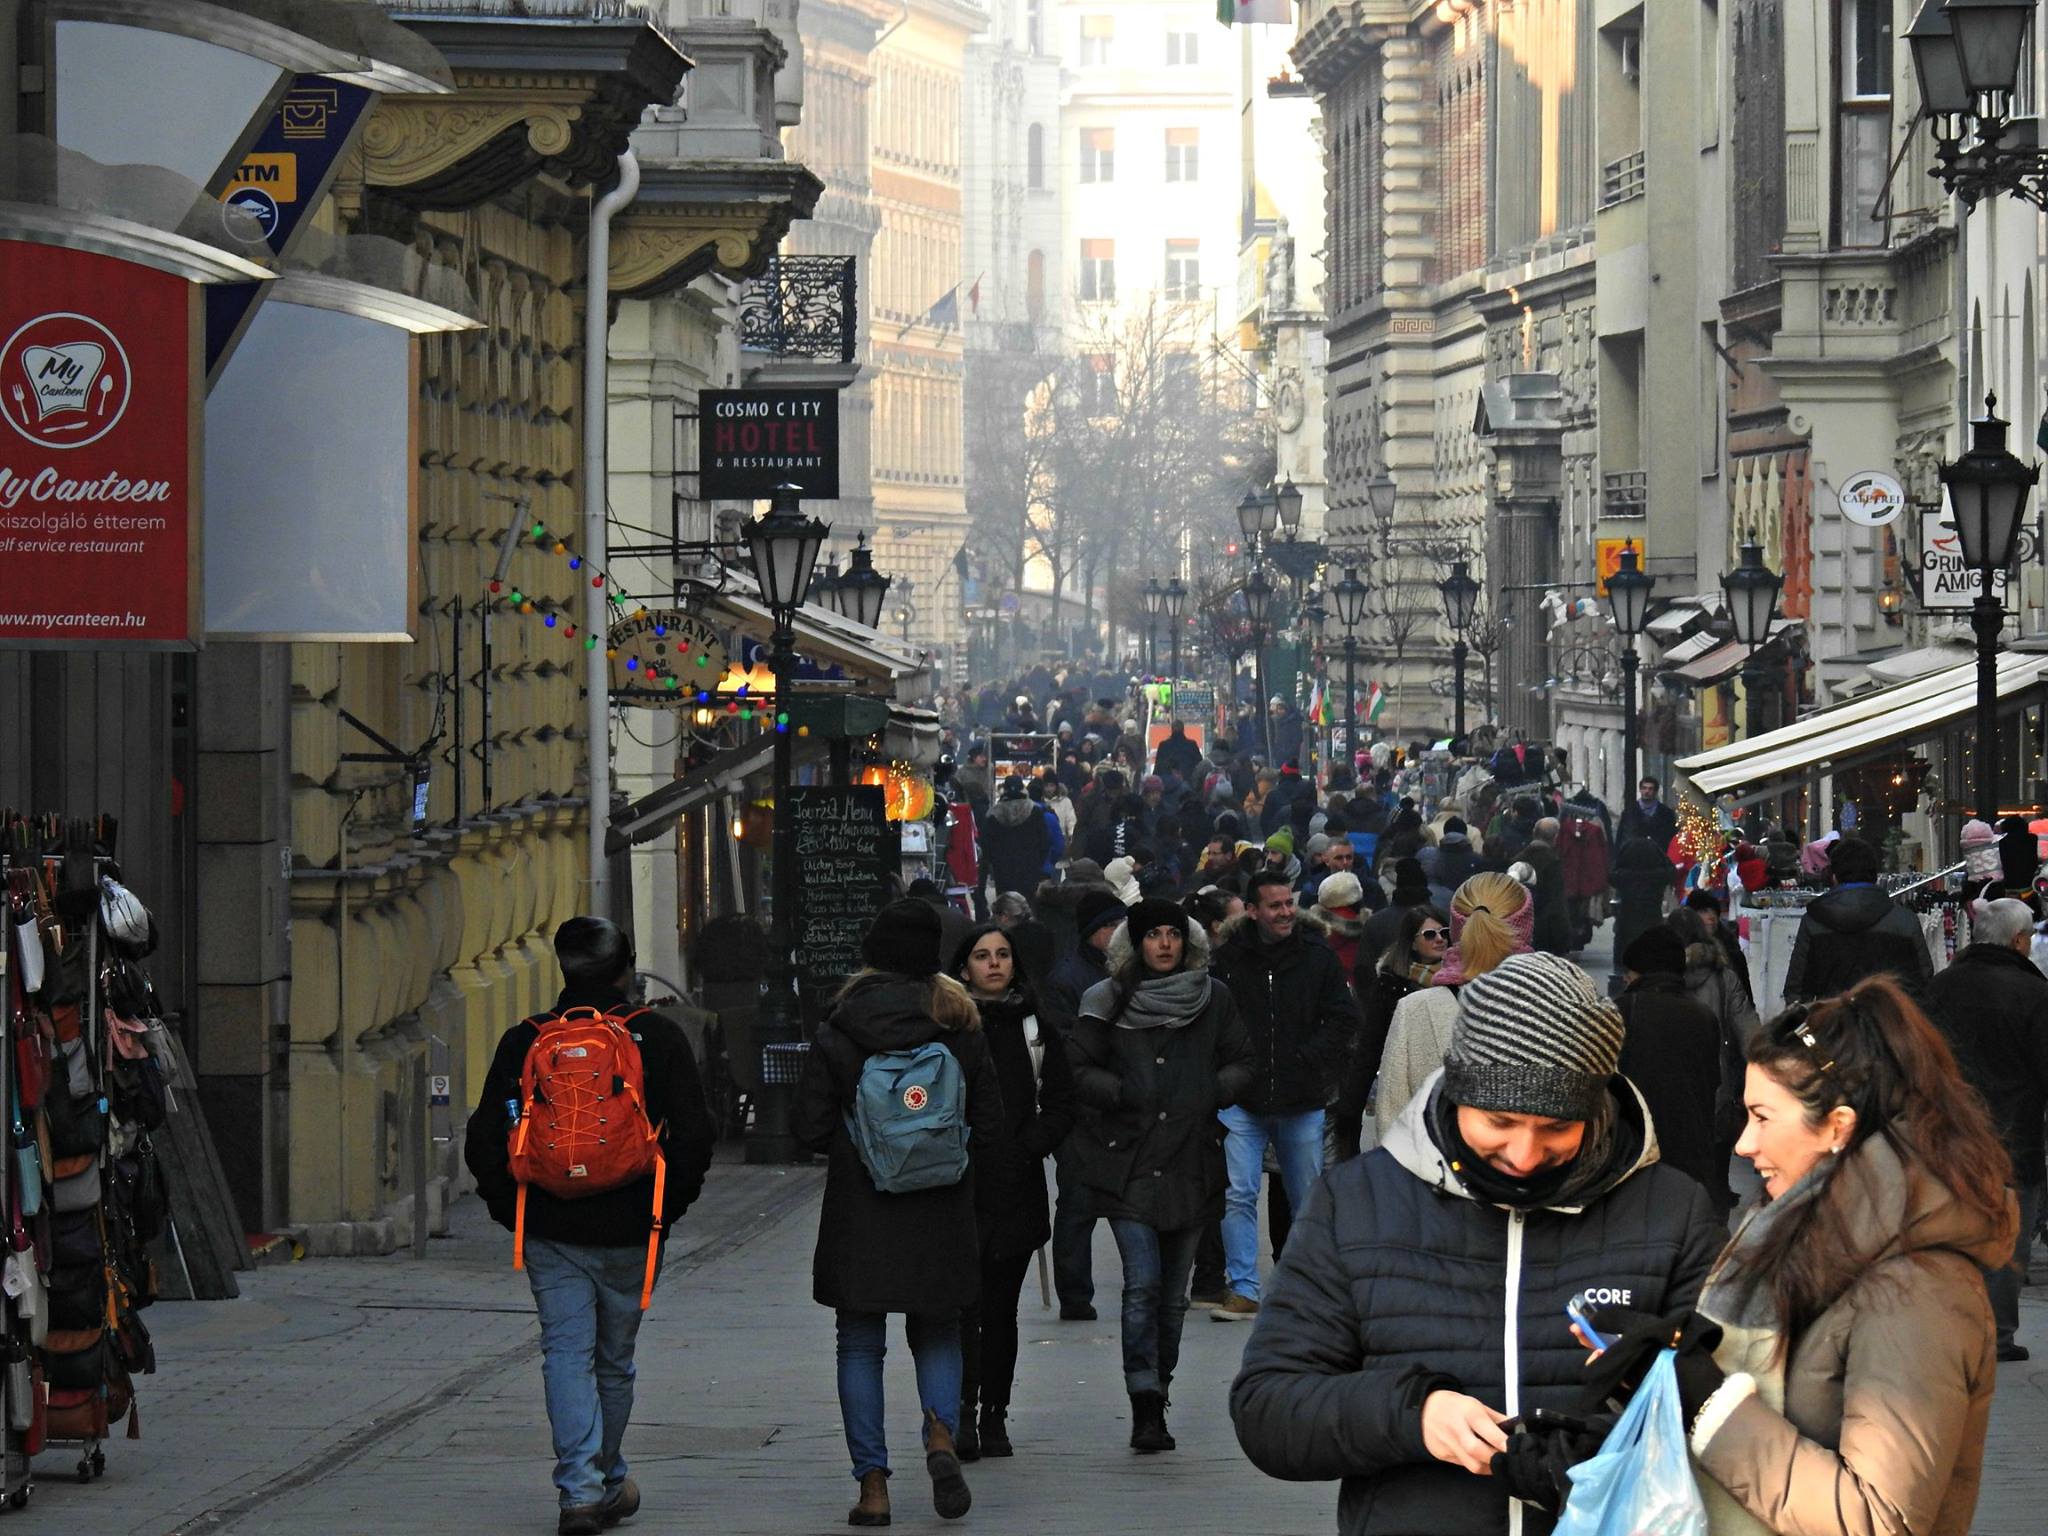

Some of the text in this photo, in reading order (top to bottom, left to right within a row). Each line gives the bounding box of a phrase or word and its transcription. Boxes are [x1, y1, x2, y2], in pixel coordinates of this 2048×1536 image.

[38, 356, 84, 385] My
[40, 383, 83, 397] Canteen
[716, 400, 821, 418] COSMO CITY
[715, 421, 821, 452] HOTEL
[716, 456, 822, 468] & RESTAURANT
[93, 512, 166, 530] étterem
[17, 538, 66, 552] service
[69, 540, 145, 553] restaurant
[1934, 571, 2006, 593] AMIGS
[1584, 1288, 1631, 1306] CORE
